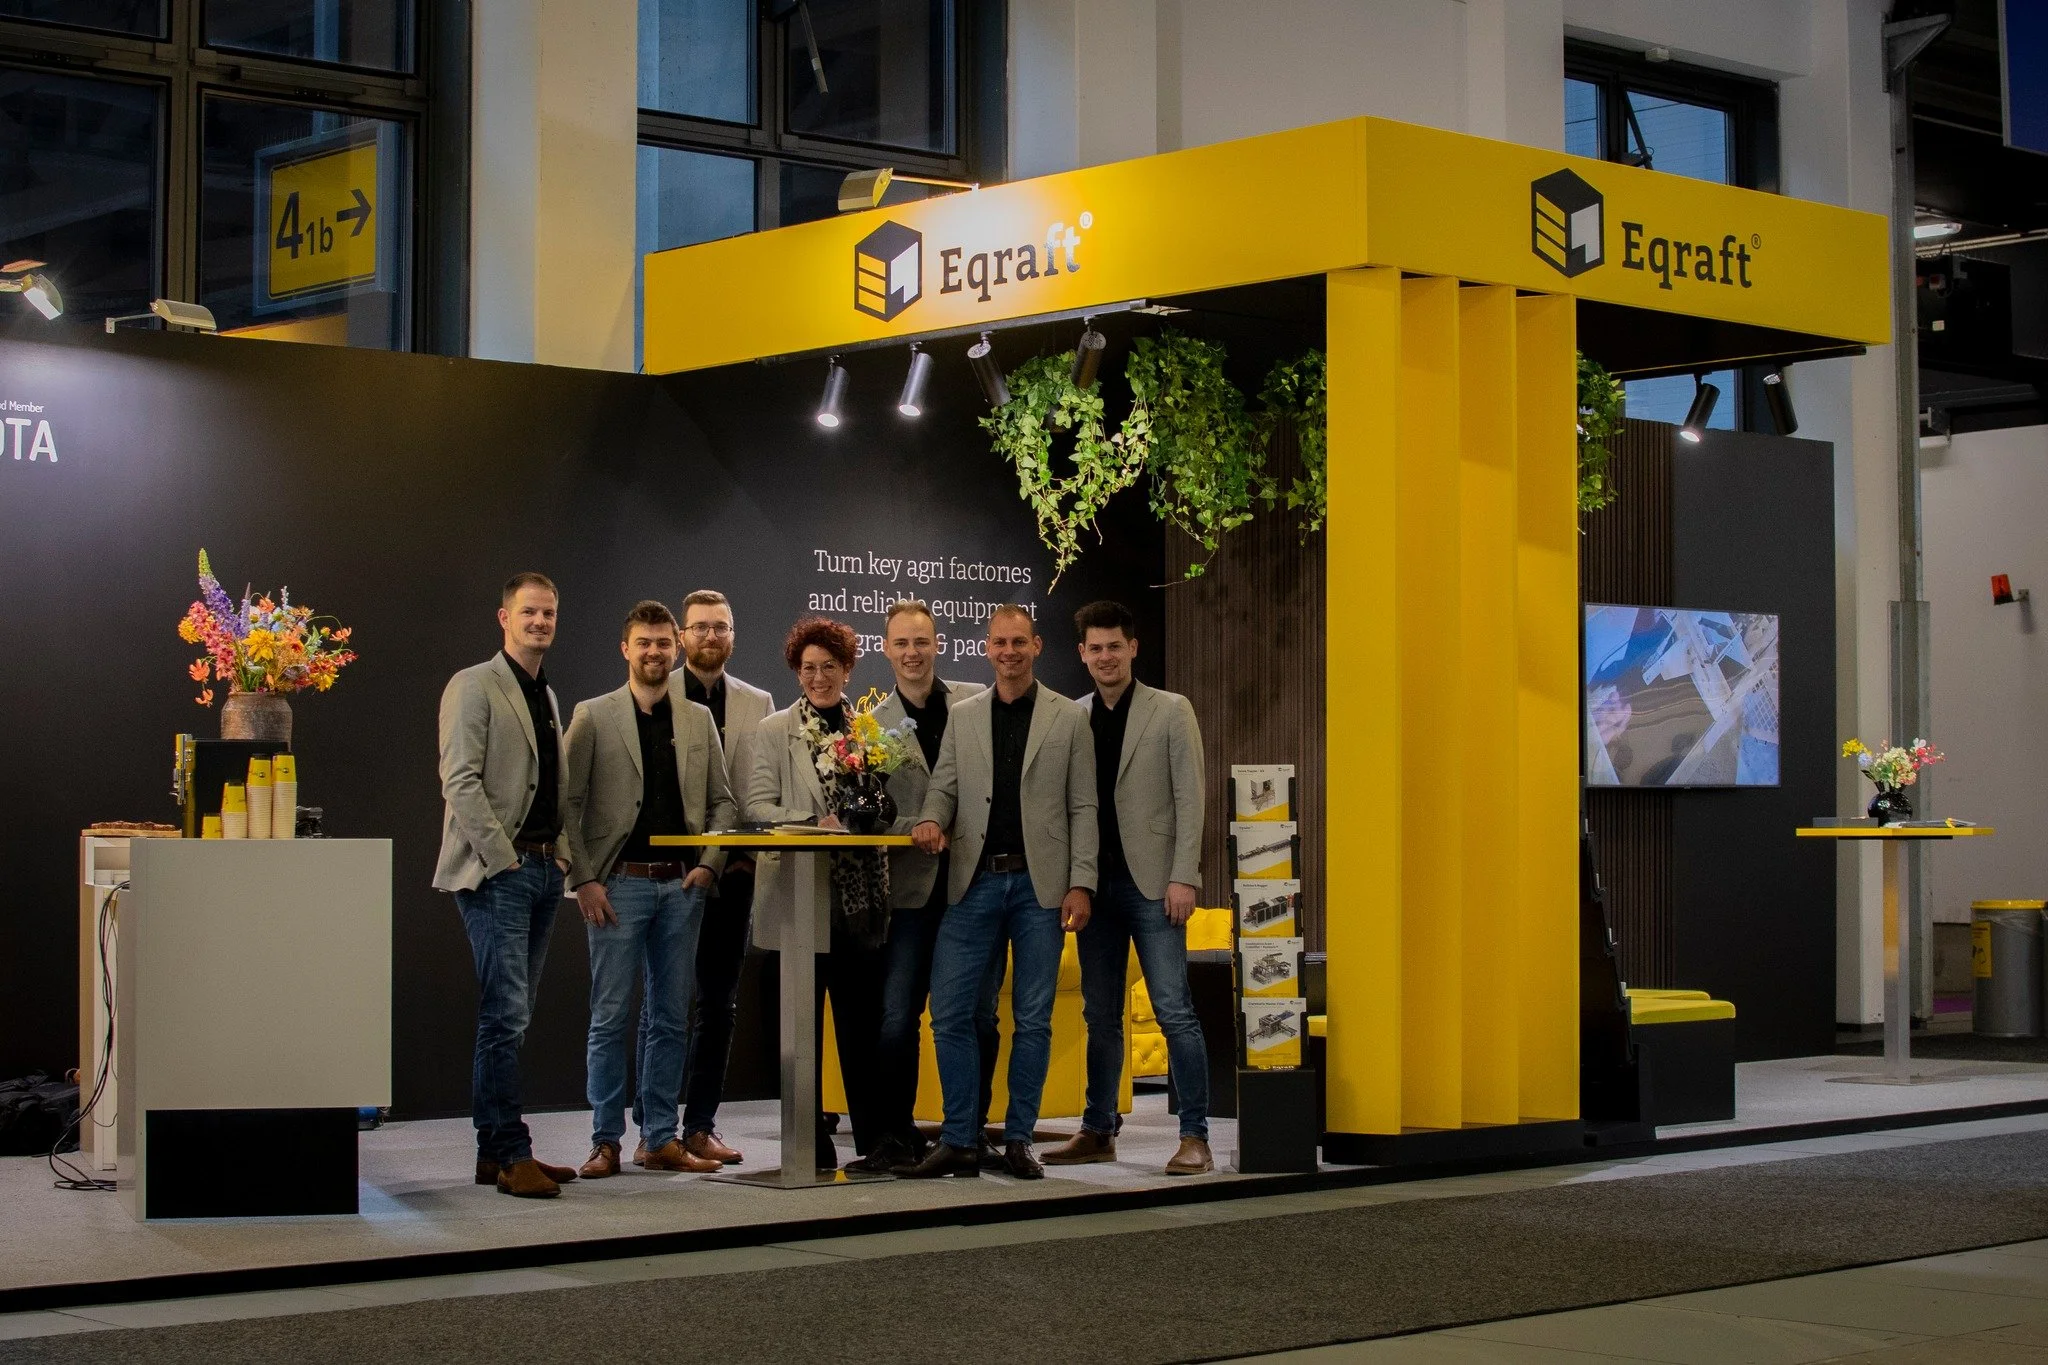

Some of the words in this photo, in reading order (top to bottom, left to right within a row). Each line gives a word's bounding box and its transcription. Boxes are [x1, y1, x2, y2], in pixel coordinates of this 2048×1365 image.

[9, 400, 45, 413] Member
[0, 417, 59, 463] TA
[814, 549, 864, 574] Turn
[868, 551, 903, 583] key
[907, 556, 945, 584] agri
[949, 556, 1032, 584] factories
[808, 588, 848, 612] and
[931, 595, 1038, 625] equipmt
